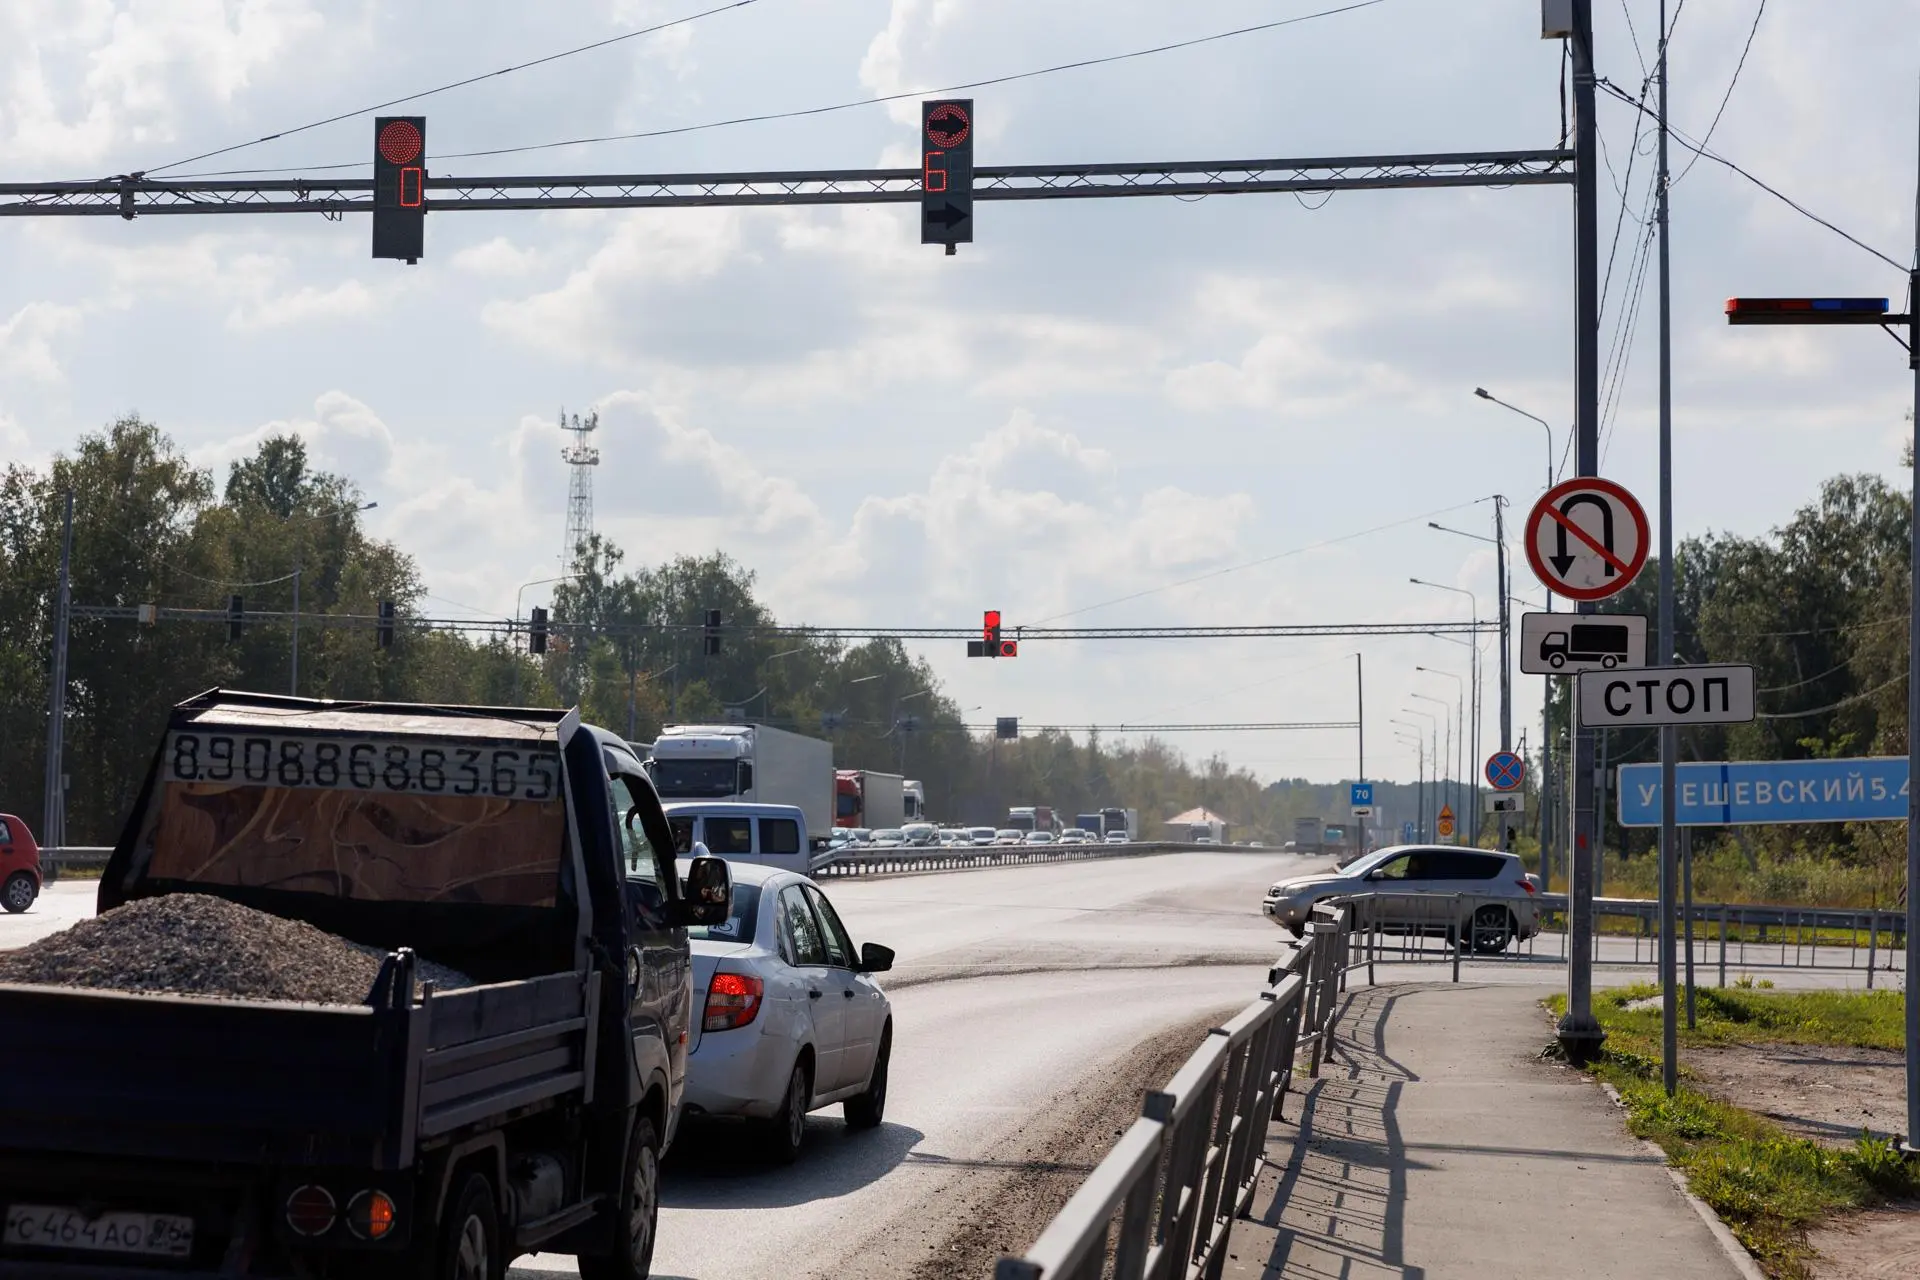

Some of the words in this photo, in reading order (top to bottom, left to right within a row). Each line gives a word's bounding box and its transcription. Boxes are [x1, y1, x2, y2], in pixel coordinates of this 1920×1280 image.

[400, 167, 421, 206] 0
[926, 151, 946, 191] 6
[1604, 678, 1729, 717] СТОП
[1355, 789, 1368, 800] 70
[1638, 772, 1864, 806] УЕШЕВСКИЙ
